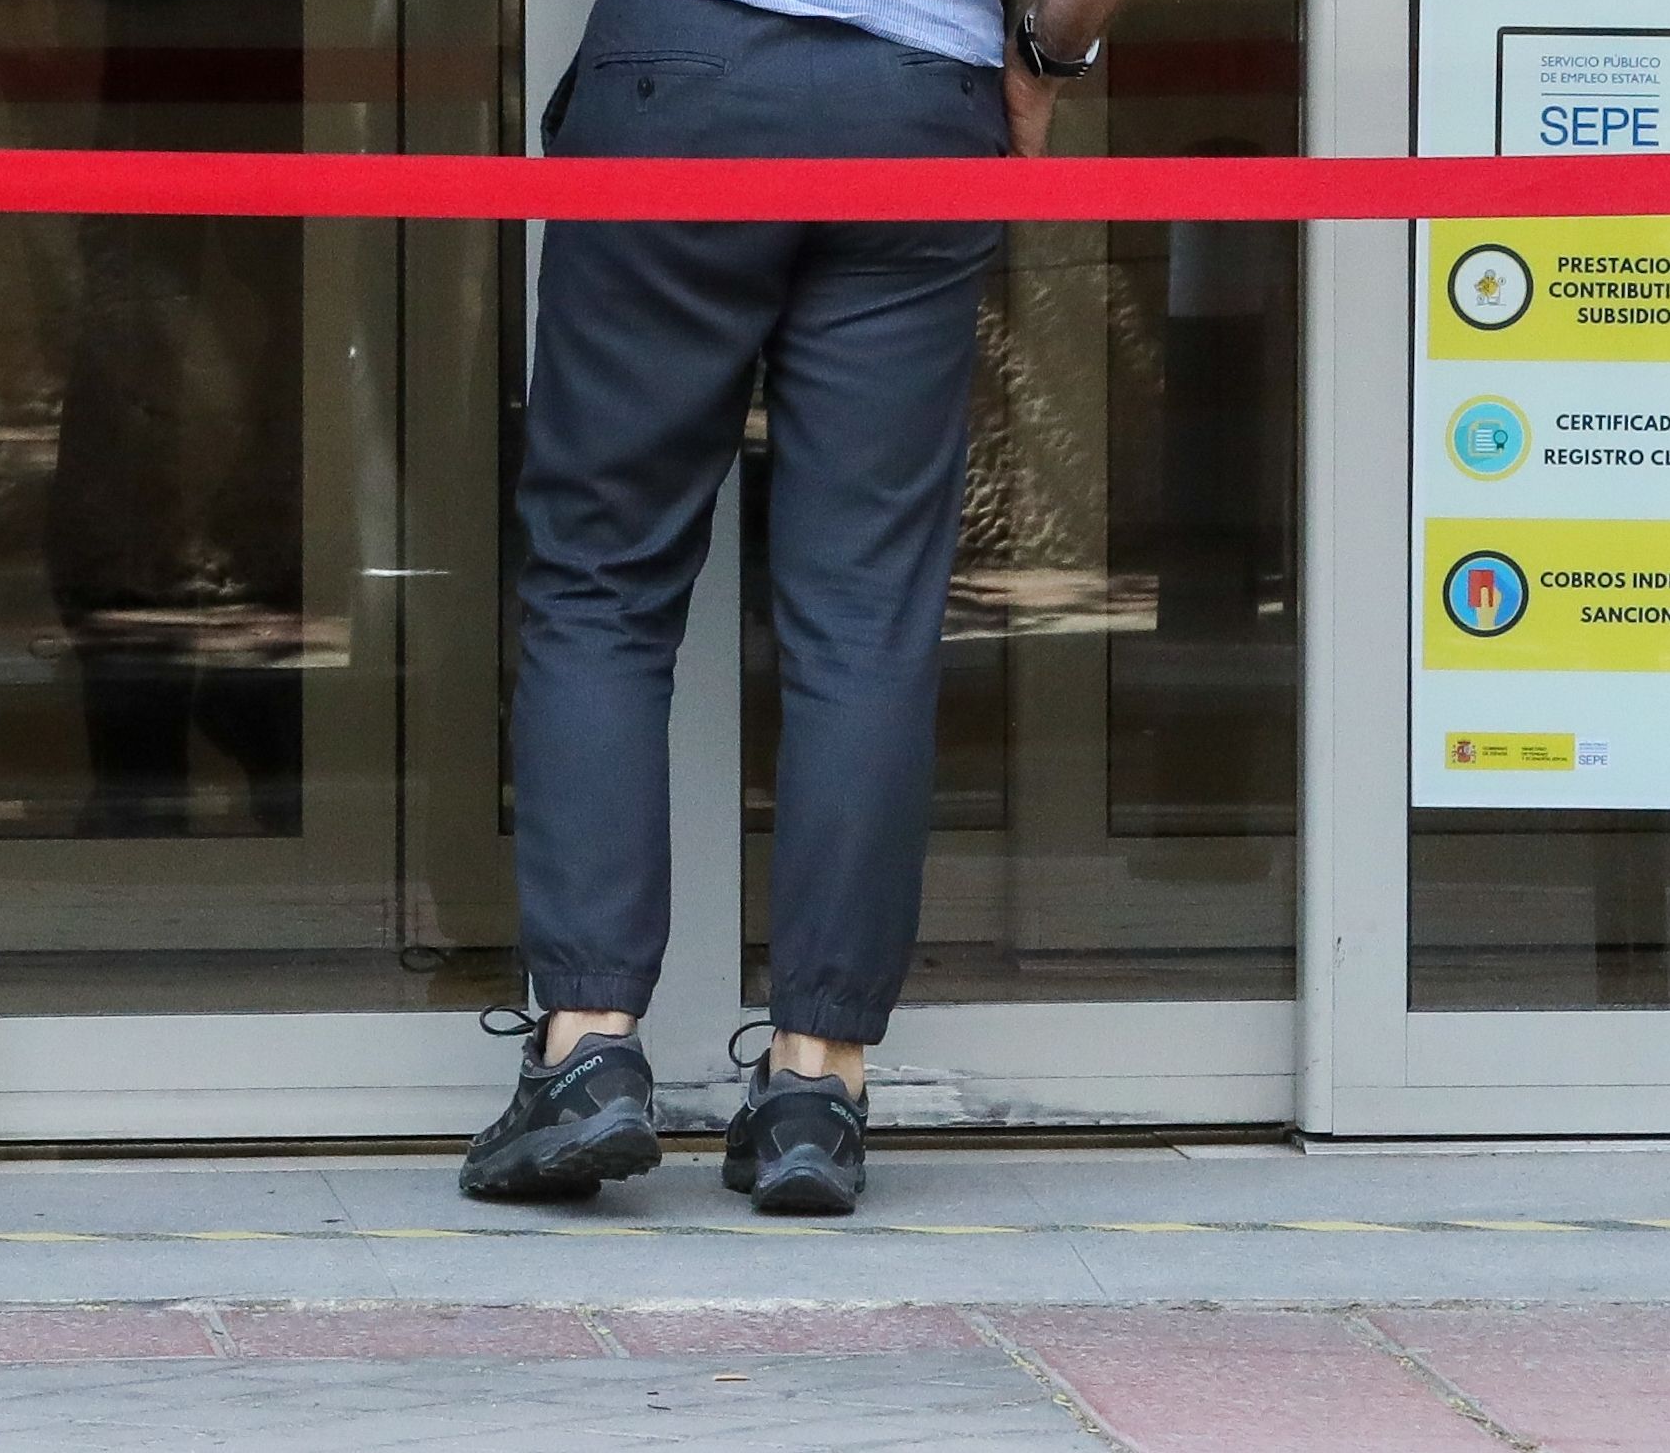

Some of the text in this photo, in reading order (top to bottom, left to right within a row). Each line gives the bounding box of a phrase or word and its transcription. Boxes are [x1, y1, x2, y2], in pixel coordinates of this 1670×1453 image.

[1541, 53, 1661, 68] SERVICIO PÚBLICO
[1540, 73, 1660, 84] DE EMPLEO ESTATAL
[1540, 105, 1659, 147] SEPE
[1544, 449, 1644, 466] REGISTRO
[1540, 571, 1626, 589] COBROS
[1578, 754, 1608, 766] SEPE
[550, 1055, 603, 1099] salomon
